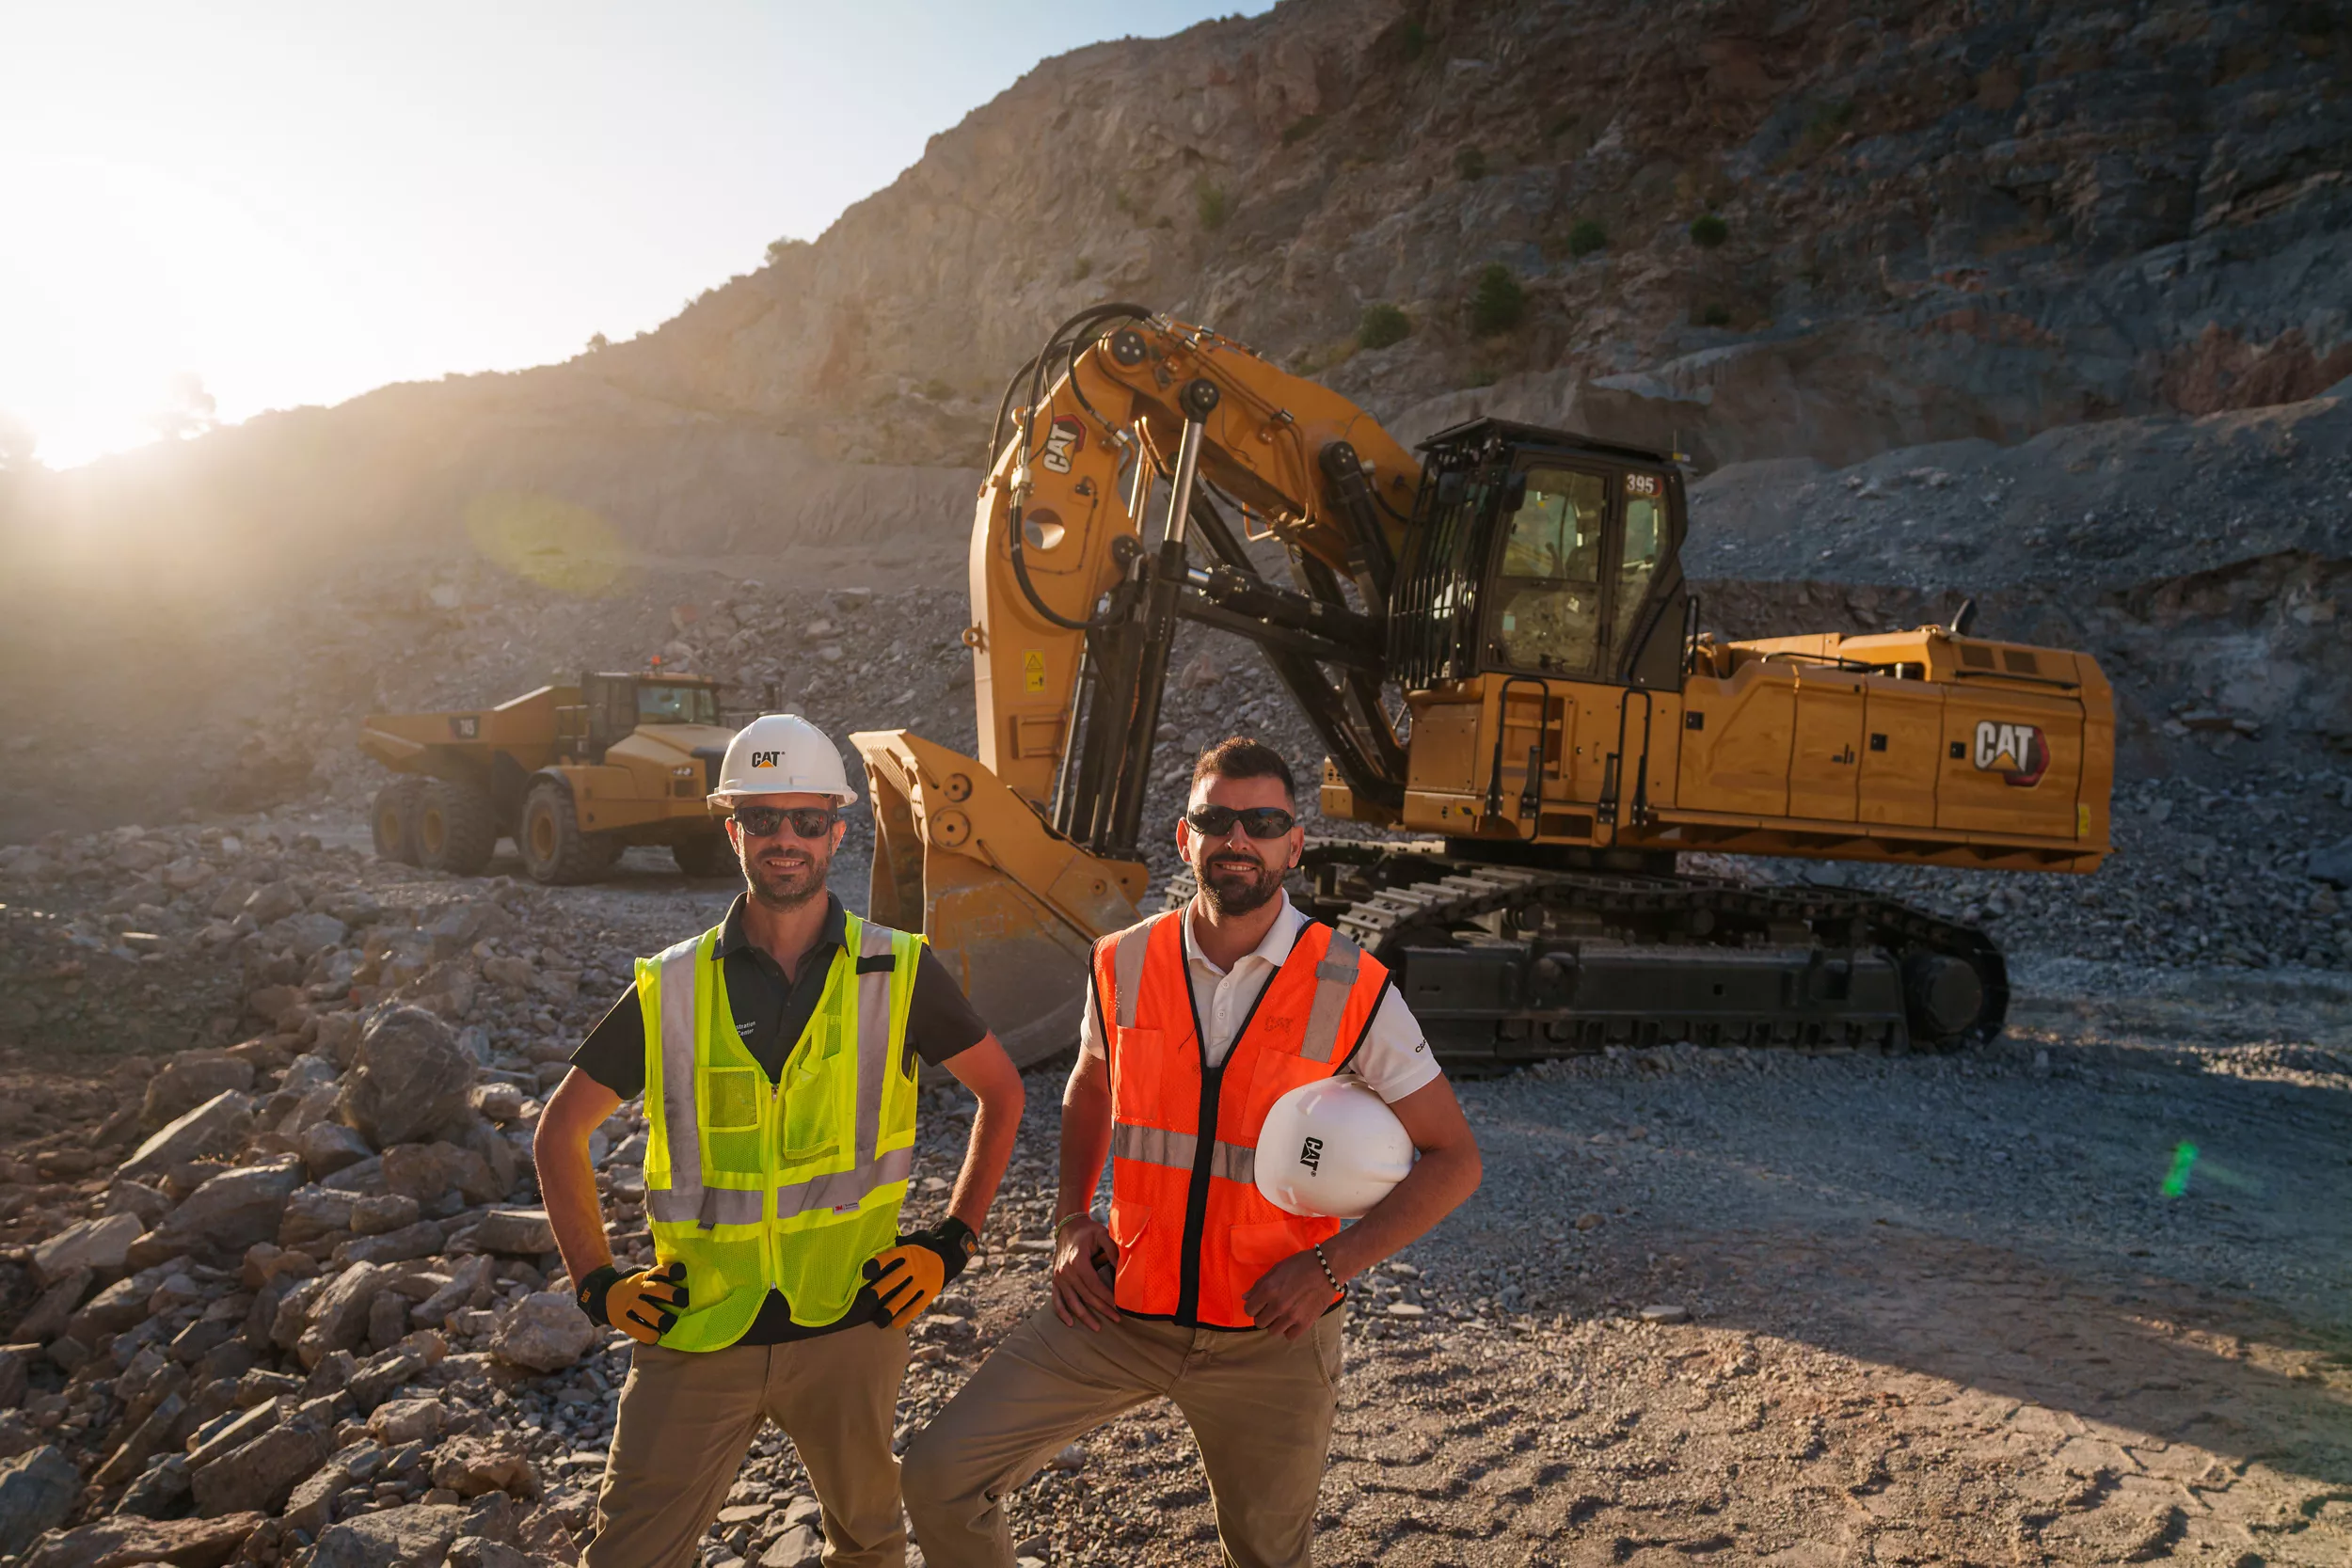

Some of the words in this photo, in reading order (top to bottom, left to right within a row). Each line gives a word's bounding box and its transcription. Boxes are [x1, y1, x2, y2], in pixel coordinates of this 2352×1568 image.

[1043, 423, 1077, 473] CAT
[1627, 473, 1654, 494] 395
[1976, 721, 2033, 771] CAT
[736, 1021, 755, 1030] stration
